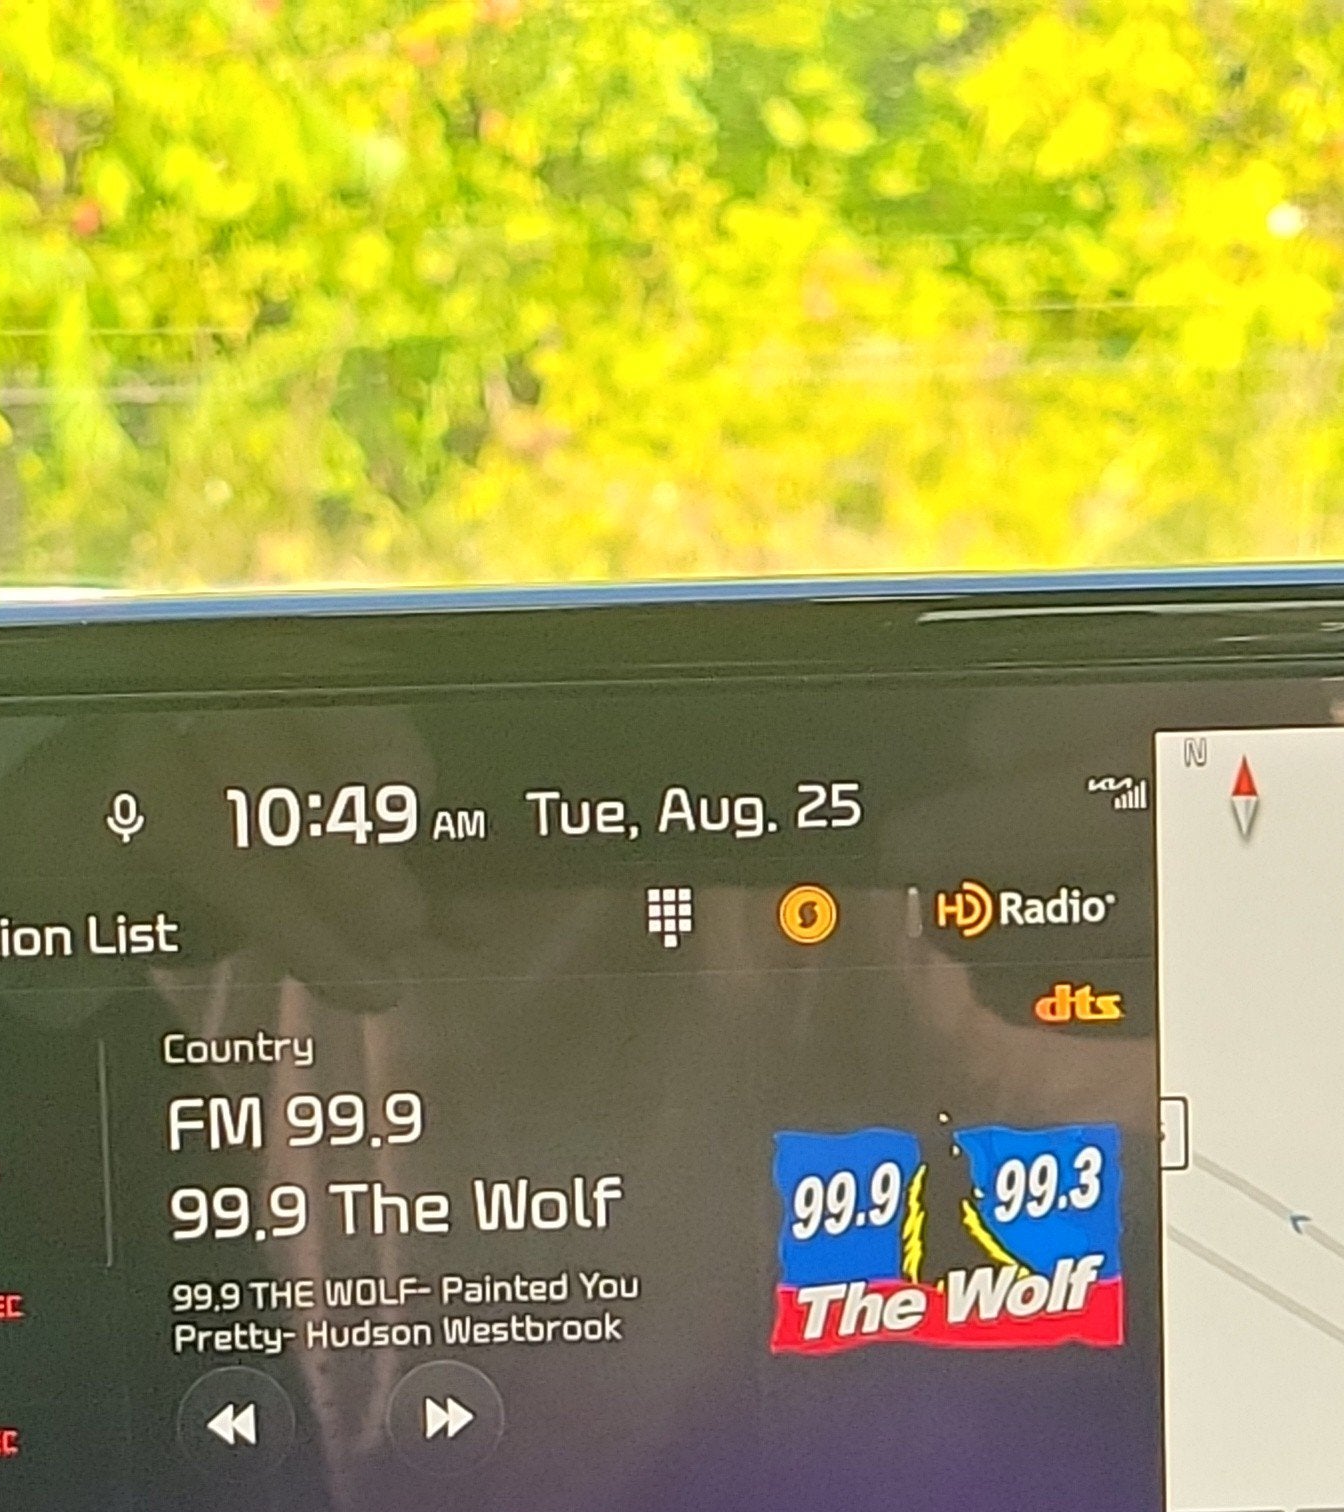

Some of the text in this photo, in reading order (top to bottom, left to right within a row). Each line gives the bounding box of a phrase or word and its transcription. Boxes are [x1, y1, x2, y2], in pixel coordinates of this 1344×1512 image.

[1183, 737, 1207, 767] N
[226, 785, 485, 848] 10:49 AM
[525, 783, 861, 840] Tue, Aug. 25
[999, 886, 1107, 926] Radio
[88, 914, 178, 954] List
[1034, 984, 1122, 1022] dts
[164, 1032, 313, 1066] Country
[169, 1093, 421, 1151] FM 99.9
[171, 1176, 622, 1241] 99.9 The Wolf
[792, 1161, 902, 1240] 99.9
[995, 1146, 1104, 1223] 99.3
[173, 1282, 240, 1312] 99.9
[249, 1280, 315, 1309] THE
[442, 1273, 568, 1304] Painted
[579, 1272, 638, 1299] You
[797, 1253, 1105, 1340] The Wolf
[307, 1319, 431, 1349] Hudson
[443, 1312, 622, 1344] Westbrook
